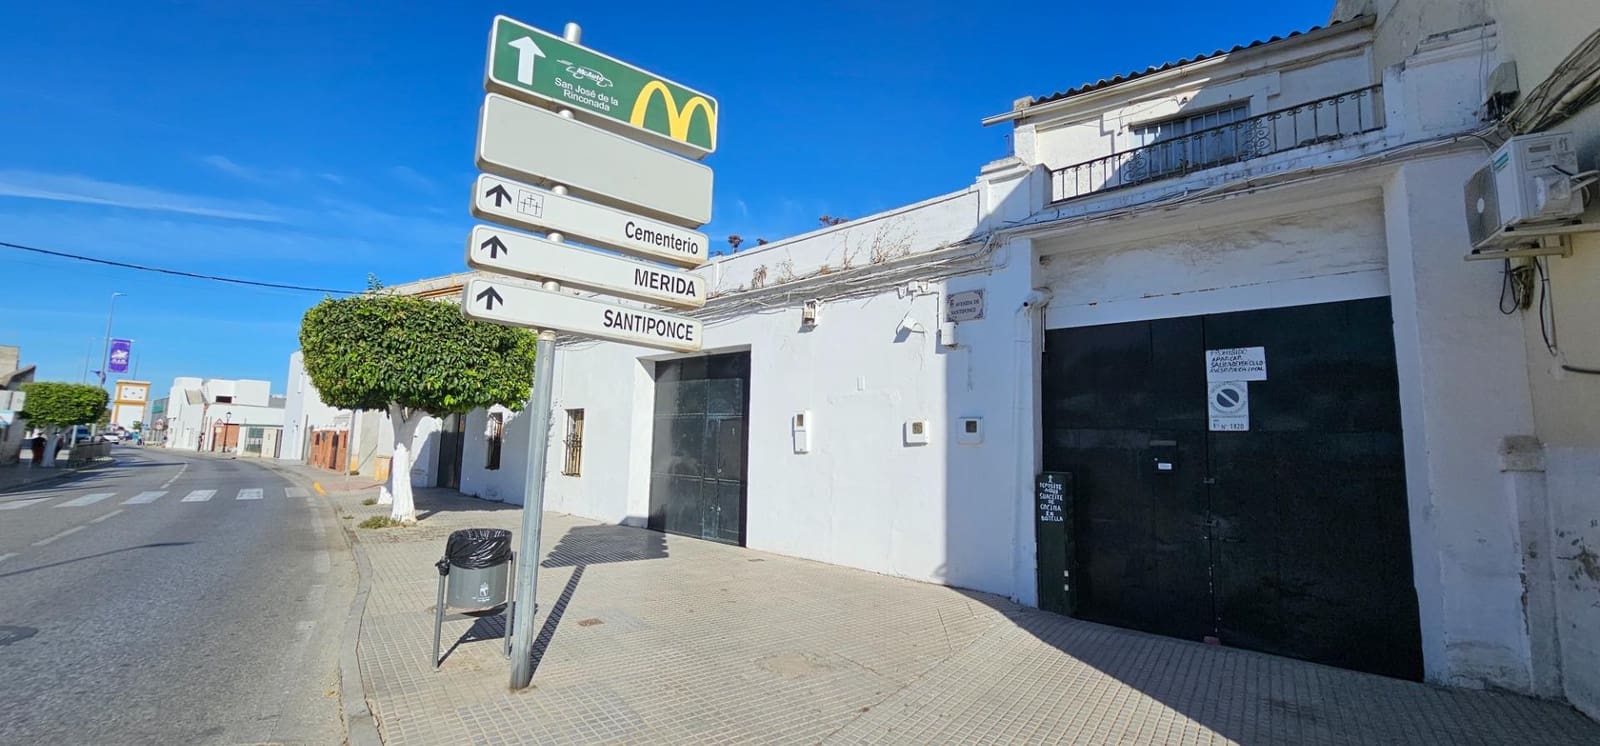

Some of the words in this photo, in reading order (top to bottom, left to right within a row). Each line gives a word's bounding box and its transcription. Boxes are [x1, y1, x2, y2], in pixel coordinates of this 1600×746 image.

[576, 67, 603, 82] McAuto
[554, 77, 573, 90] San
[575, 84, 596, 98] José
[597, 92, 609, 103] de
[610, 96, 619, 106] la
[563, 88, 611, 112] Rinconada
[625, 221, 698, 255] Cementerio
[634, 268, 696, 297] MERIDA
[603, 309, 694, 341] SANTIPONCE
